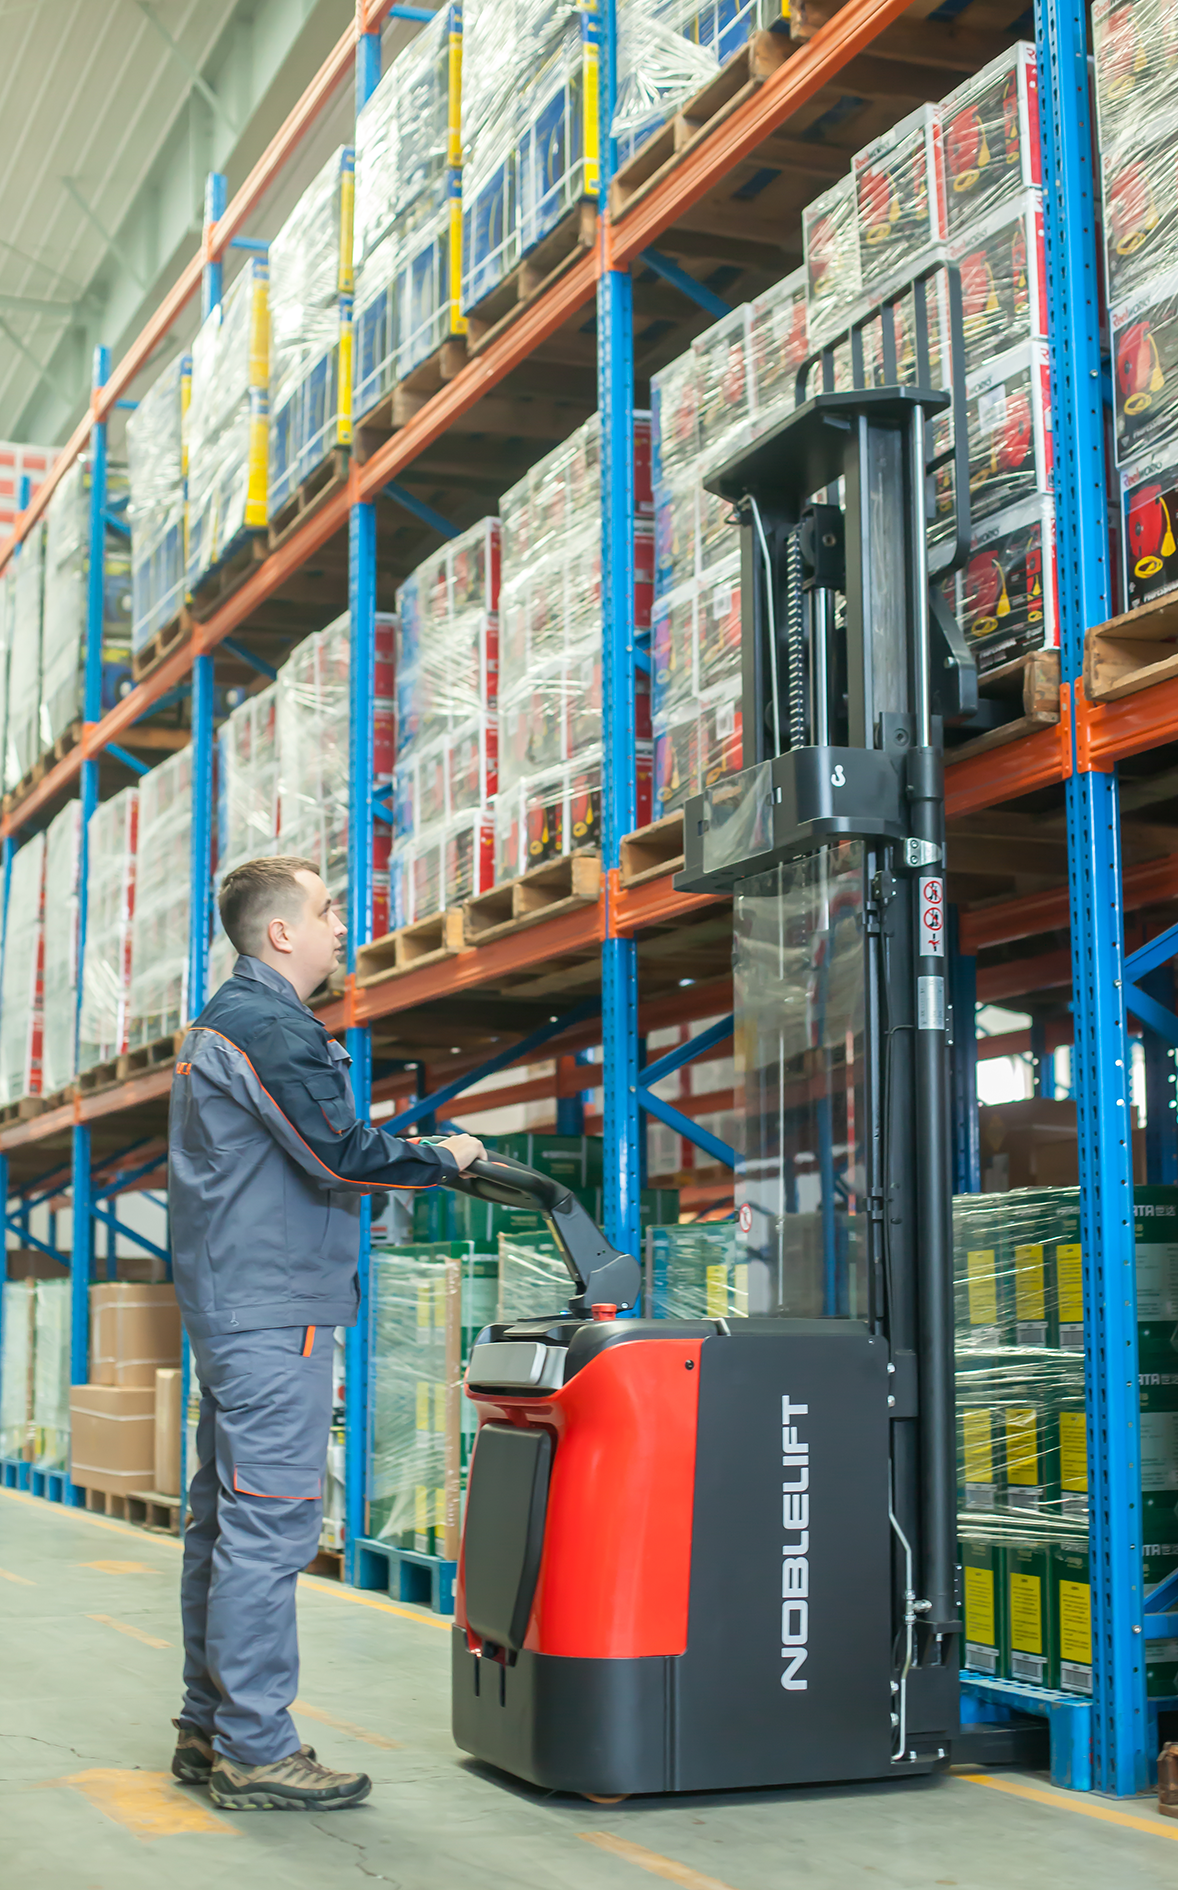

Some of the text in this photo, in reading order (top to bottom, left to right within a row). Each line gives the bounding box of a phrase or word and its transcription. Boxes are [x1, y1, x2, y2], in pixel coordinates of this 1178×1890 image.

[1133, 1204, 1154, 1217] ATA
[1138, 1373, 1160, 1386] ATA
[780, 1394, 810, 1691] NOBLELIFT
